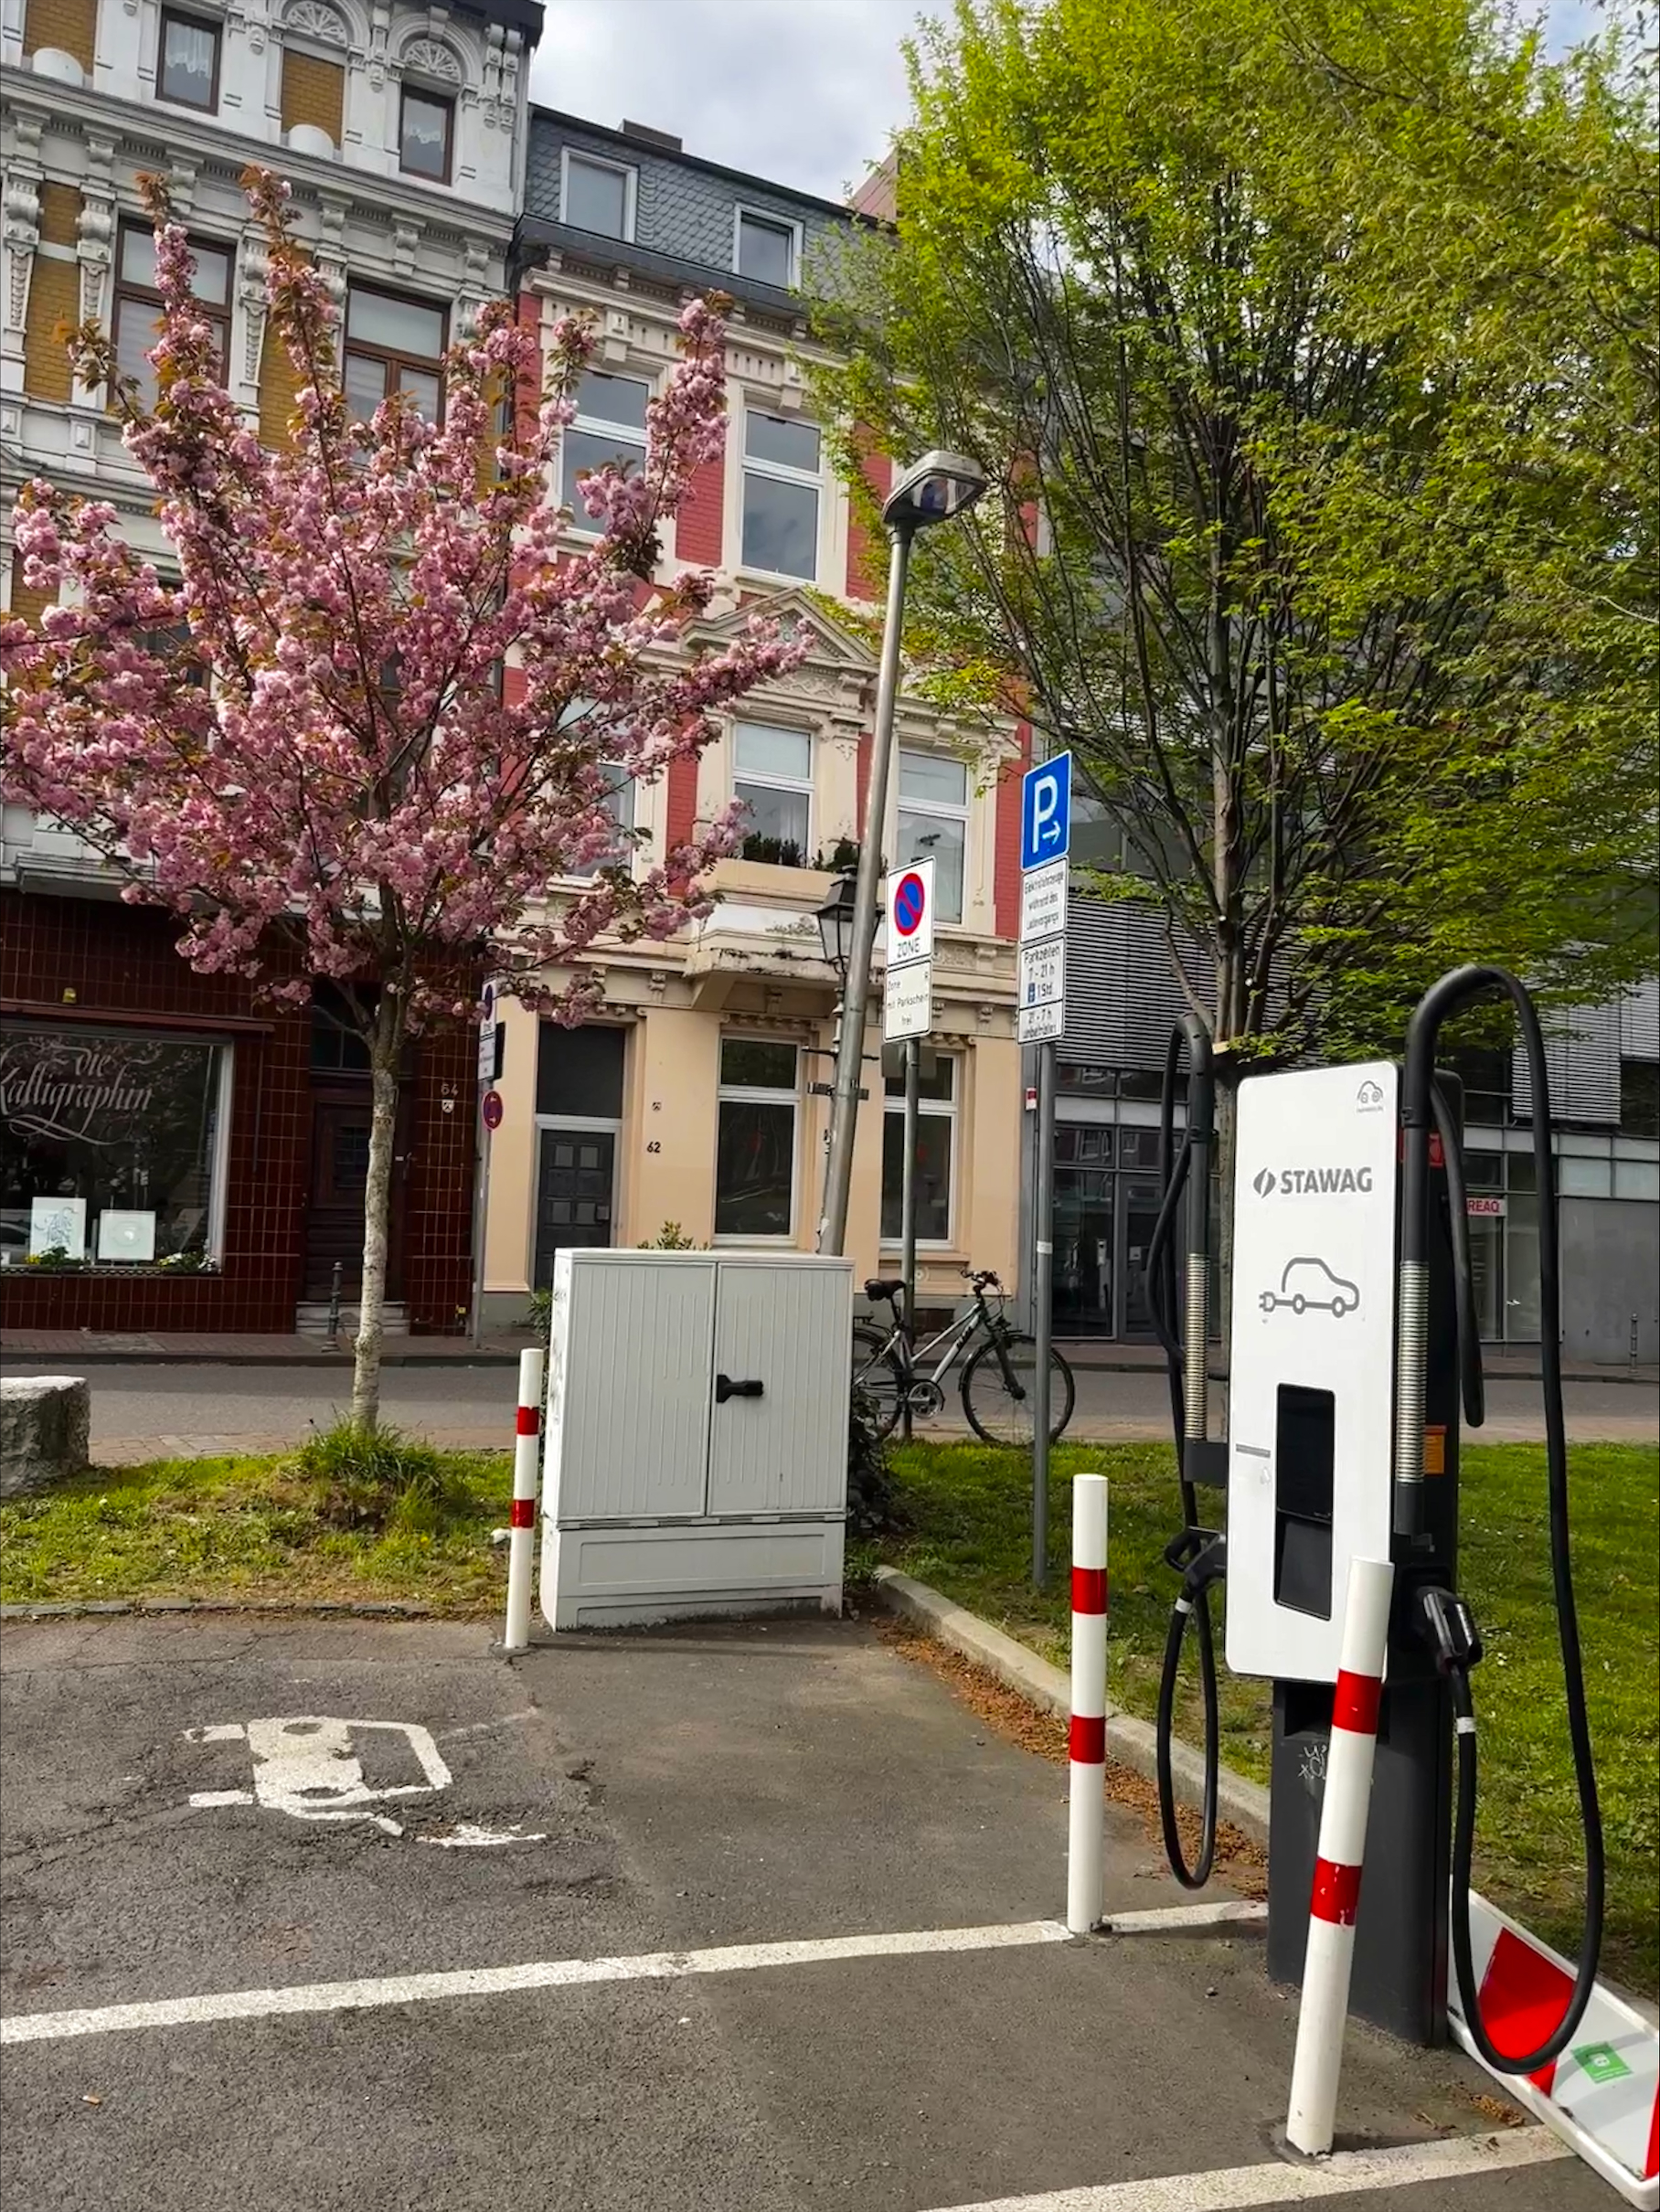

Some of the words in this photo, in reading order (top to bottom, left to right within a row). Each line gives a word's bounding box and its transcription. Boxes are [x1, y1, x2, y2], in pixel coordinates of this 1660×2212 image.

[1032, 774, 1059, 854] P
[897, 936, 920, 958] ZONE
[1024, 945, 1060, 963] Parkzeiten
[887, 980, 901, 993] Zone
[646, 1141, 662, 1154] 62
[1281, 1166, 1373, 1195] STAWAG
